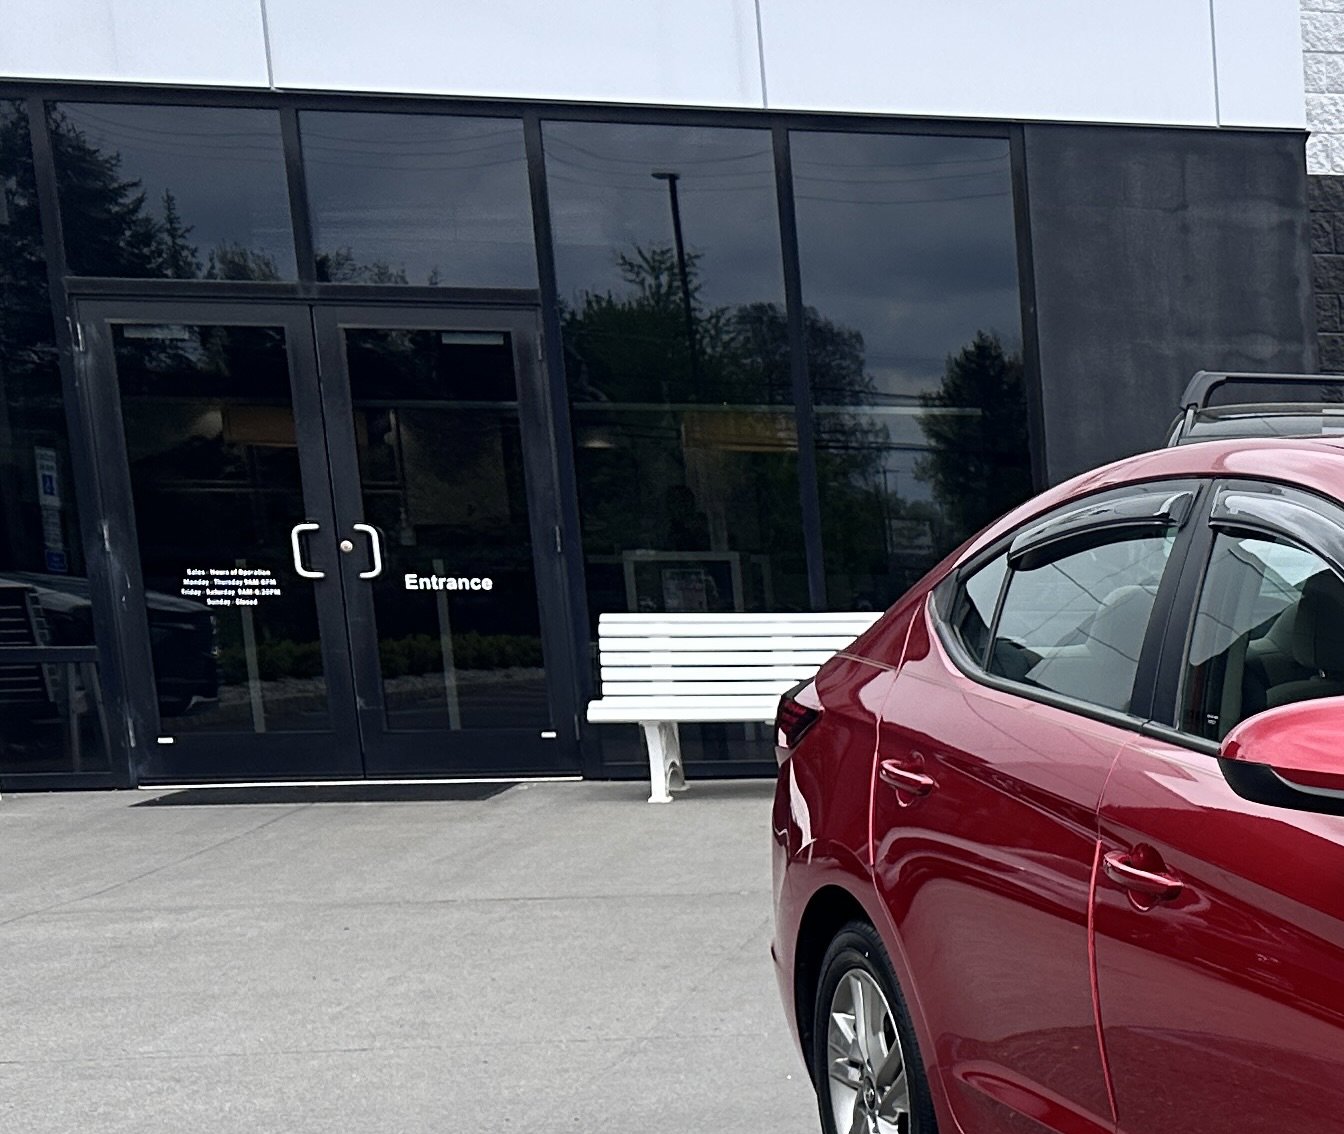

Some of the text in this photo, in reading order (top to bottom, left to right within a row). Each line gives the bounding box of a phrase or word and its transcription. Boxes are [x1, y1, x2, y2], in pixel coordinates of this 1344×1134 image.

[187, 568, 206, 576] Sales
[238, 568, 271, 577] Operation
[183, 578, 210, 587] Monday
[214, 578, 244, 587] Thursday
[404, 573, 493, 590] Entrance
[181, 587, 202, 597] Friday
[206, 587, 236, 597] Saturday
[207, 597, 231, 607] Sunday
[235, 597, 258, 606] Closed
